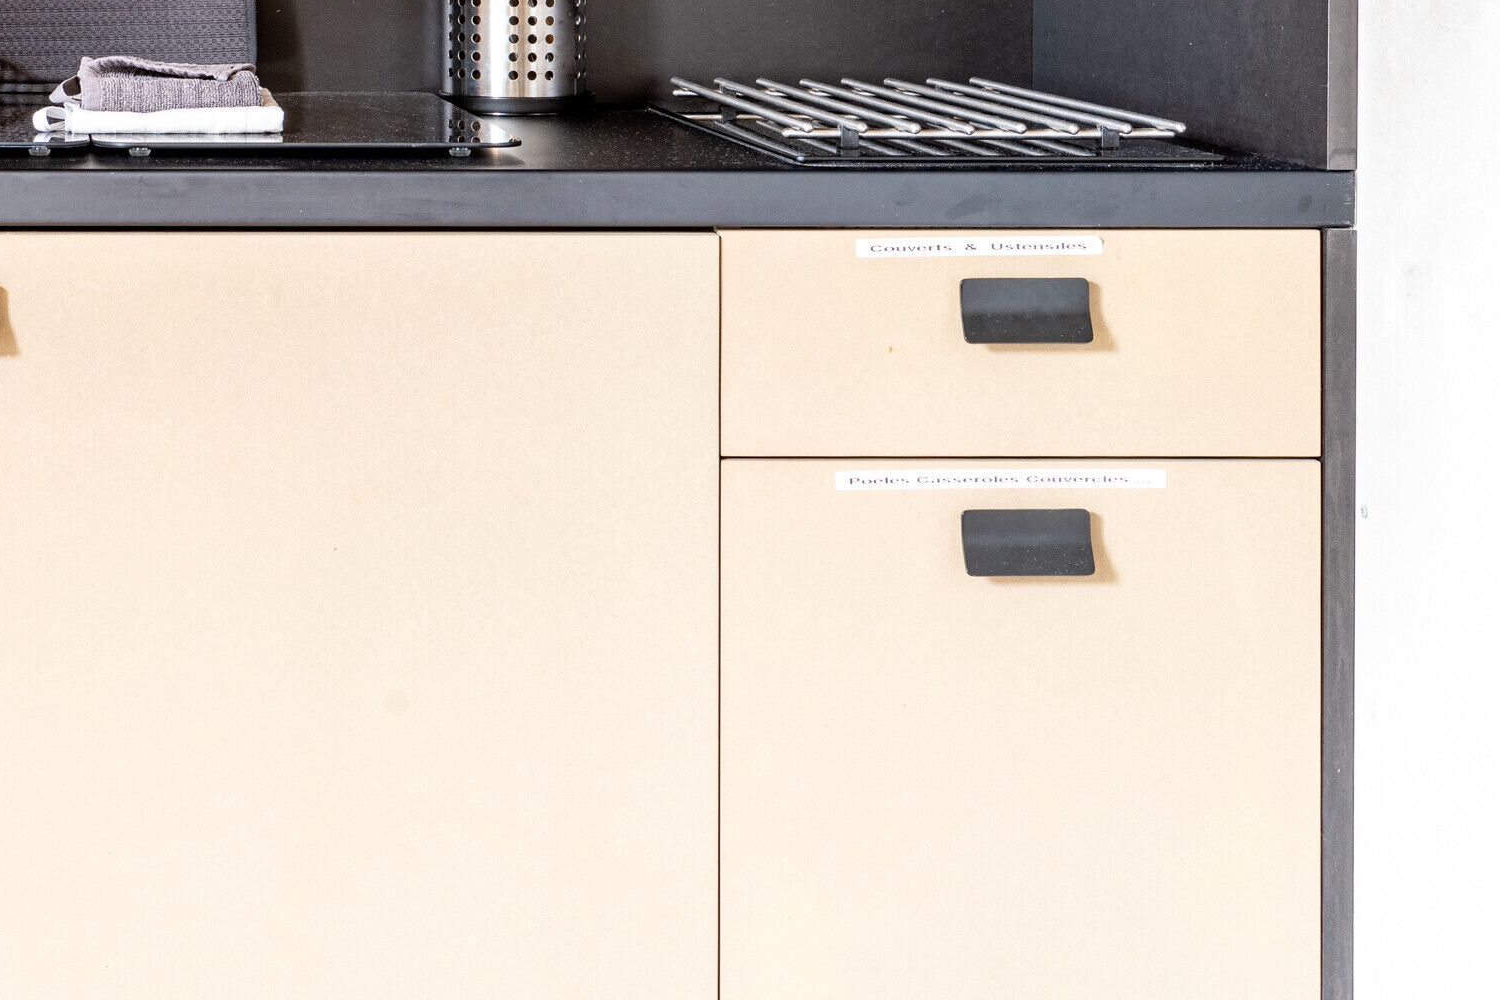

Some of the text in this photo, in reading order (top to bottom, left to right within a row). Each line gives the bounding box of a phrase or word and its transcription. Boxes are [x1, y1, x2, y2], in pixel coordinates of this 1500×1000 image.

[870, 242, 1088, 252] Couverts & Ustensiles
[916, 475, 1019, 484] Casseroles
[1026, 475, 1129, 483] Couvercles
